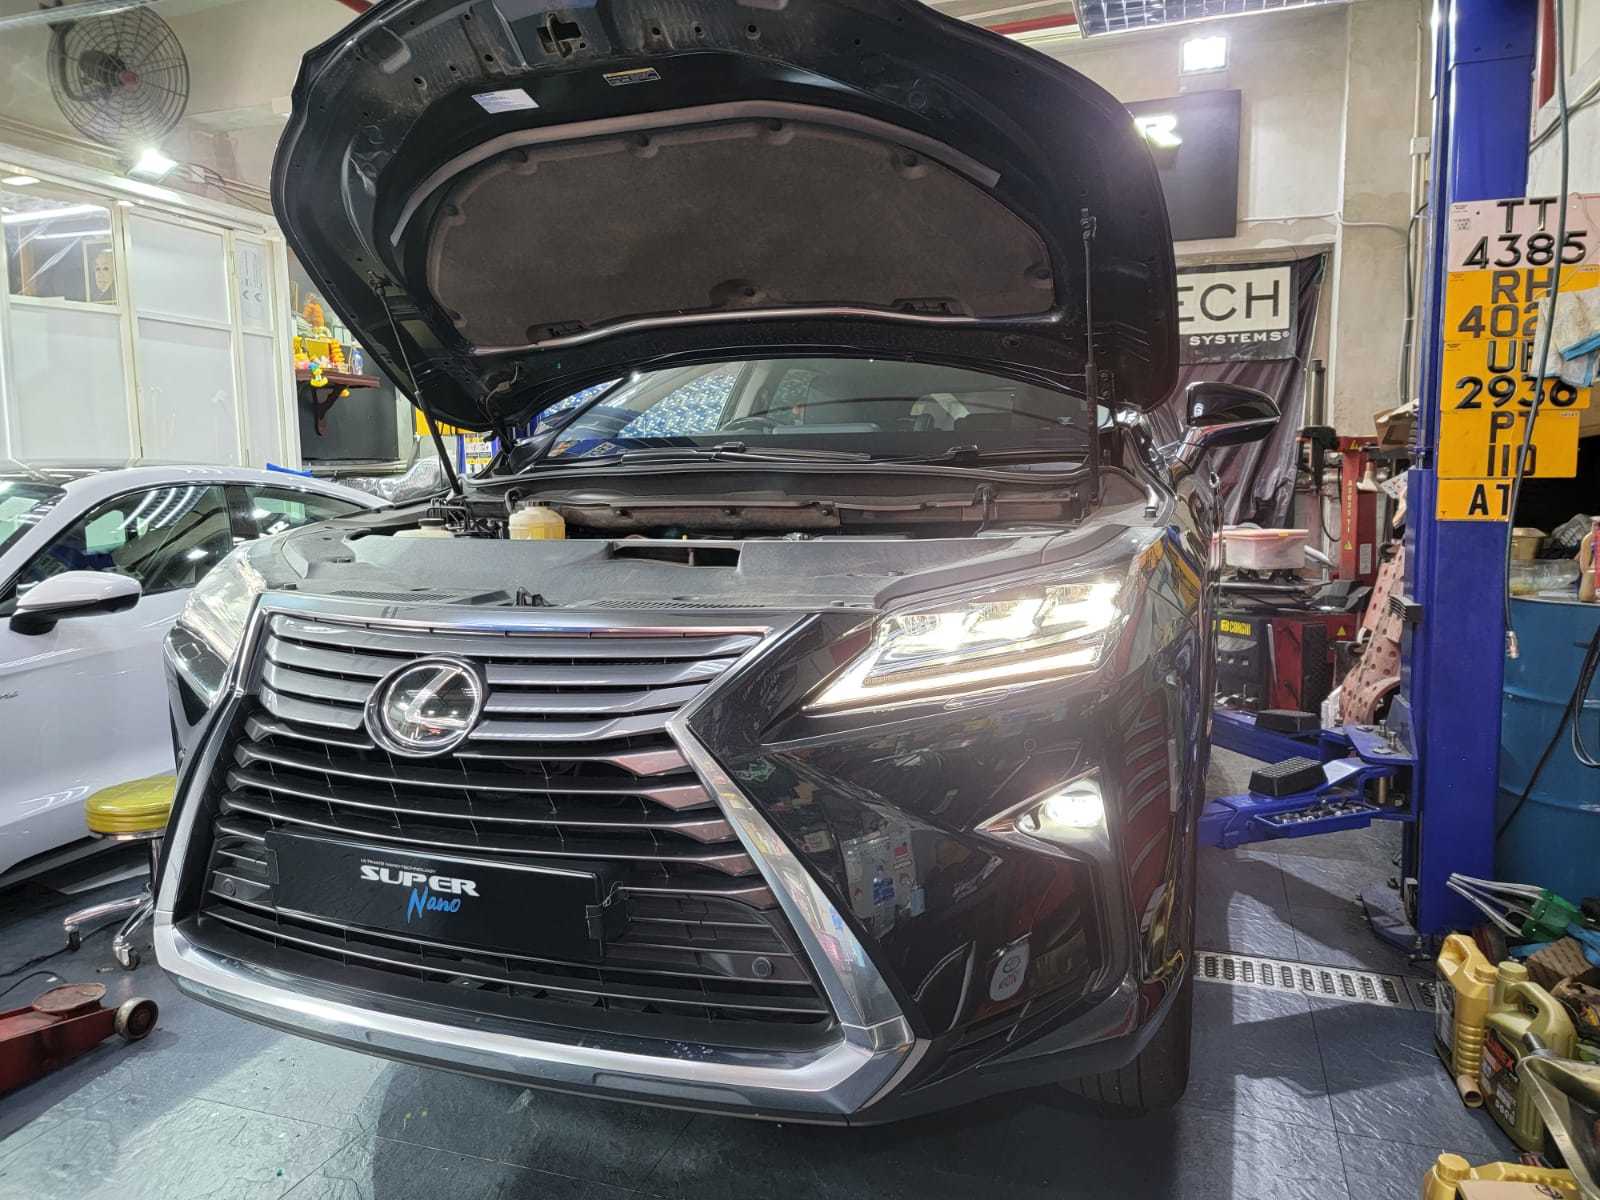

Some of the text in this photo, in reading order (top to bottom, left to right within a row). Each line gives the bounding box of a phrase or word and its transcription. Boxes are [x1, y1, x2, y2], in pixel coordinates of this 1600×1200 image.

[1497, 198, 1557, 233] TT
[1462, 231, 1587, 269] 4385
[1491, 268, 1554, 304] RH
[1455, 374, 1578, 409] 2936
[1490, 411, 1539, 444] PT
[360, 864, 480, 897] SUPER
[406, 885, 461, 924] Nano
